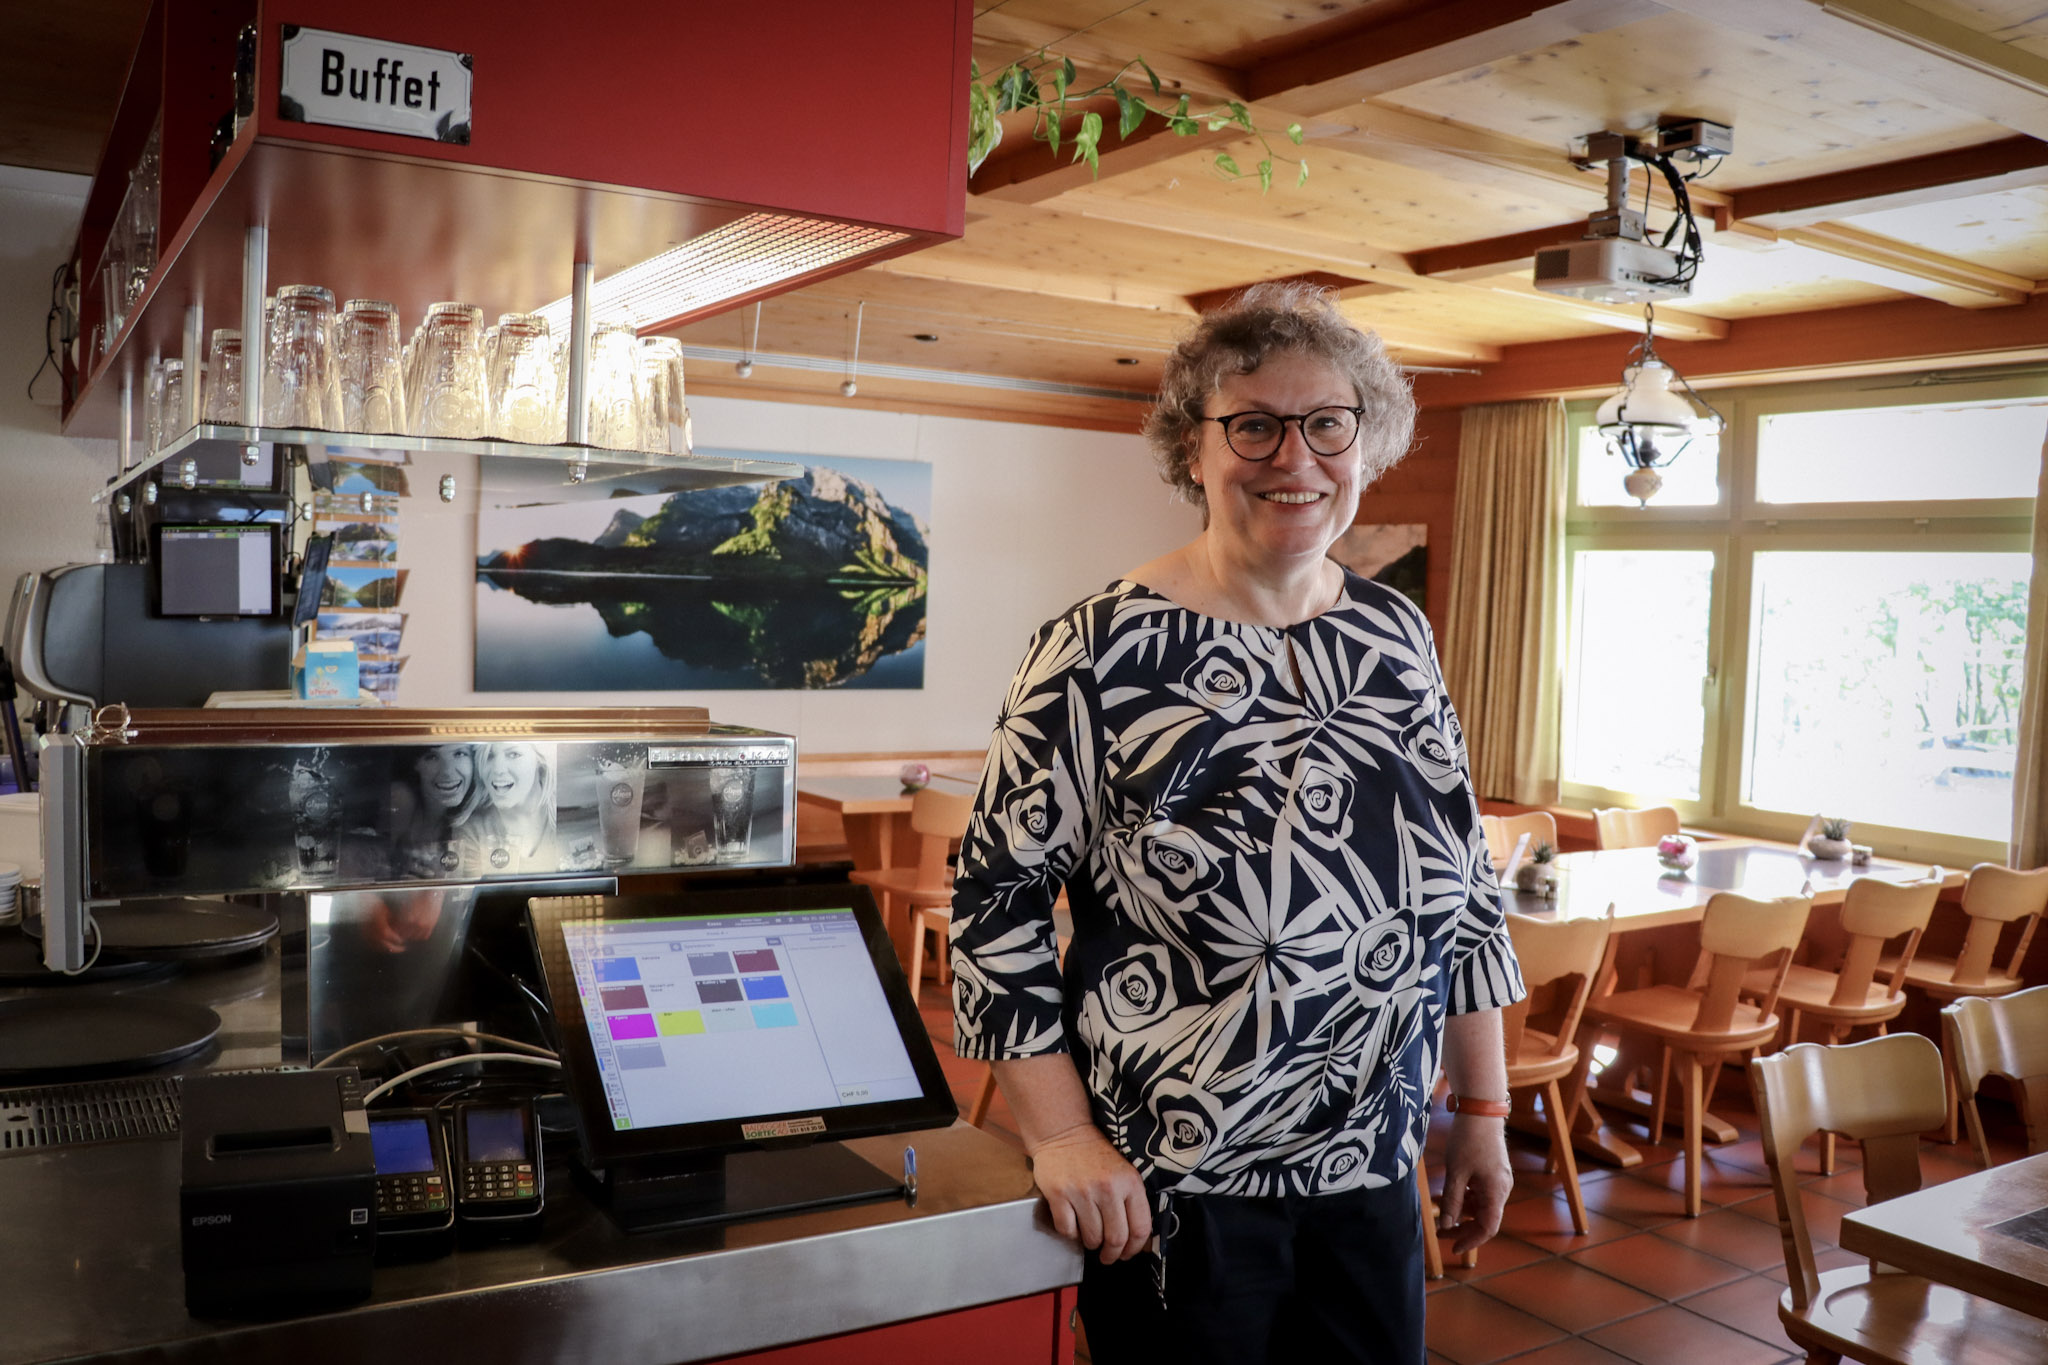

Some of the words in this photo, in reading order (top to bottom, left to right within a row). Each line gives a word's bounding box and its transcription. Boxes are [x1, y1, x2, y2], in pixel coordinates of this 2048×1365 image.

[321, 48, 441, 111] Buffet
[746, 1129, 777, 1138] SORTEC
[192, 1214, 232, 1226] EPSON
